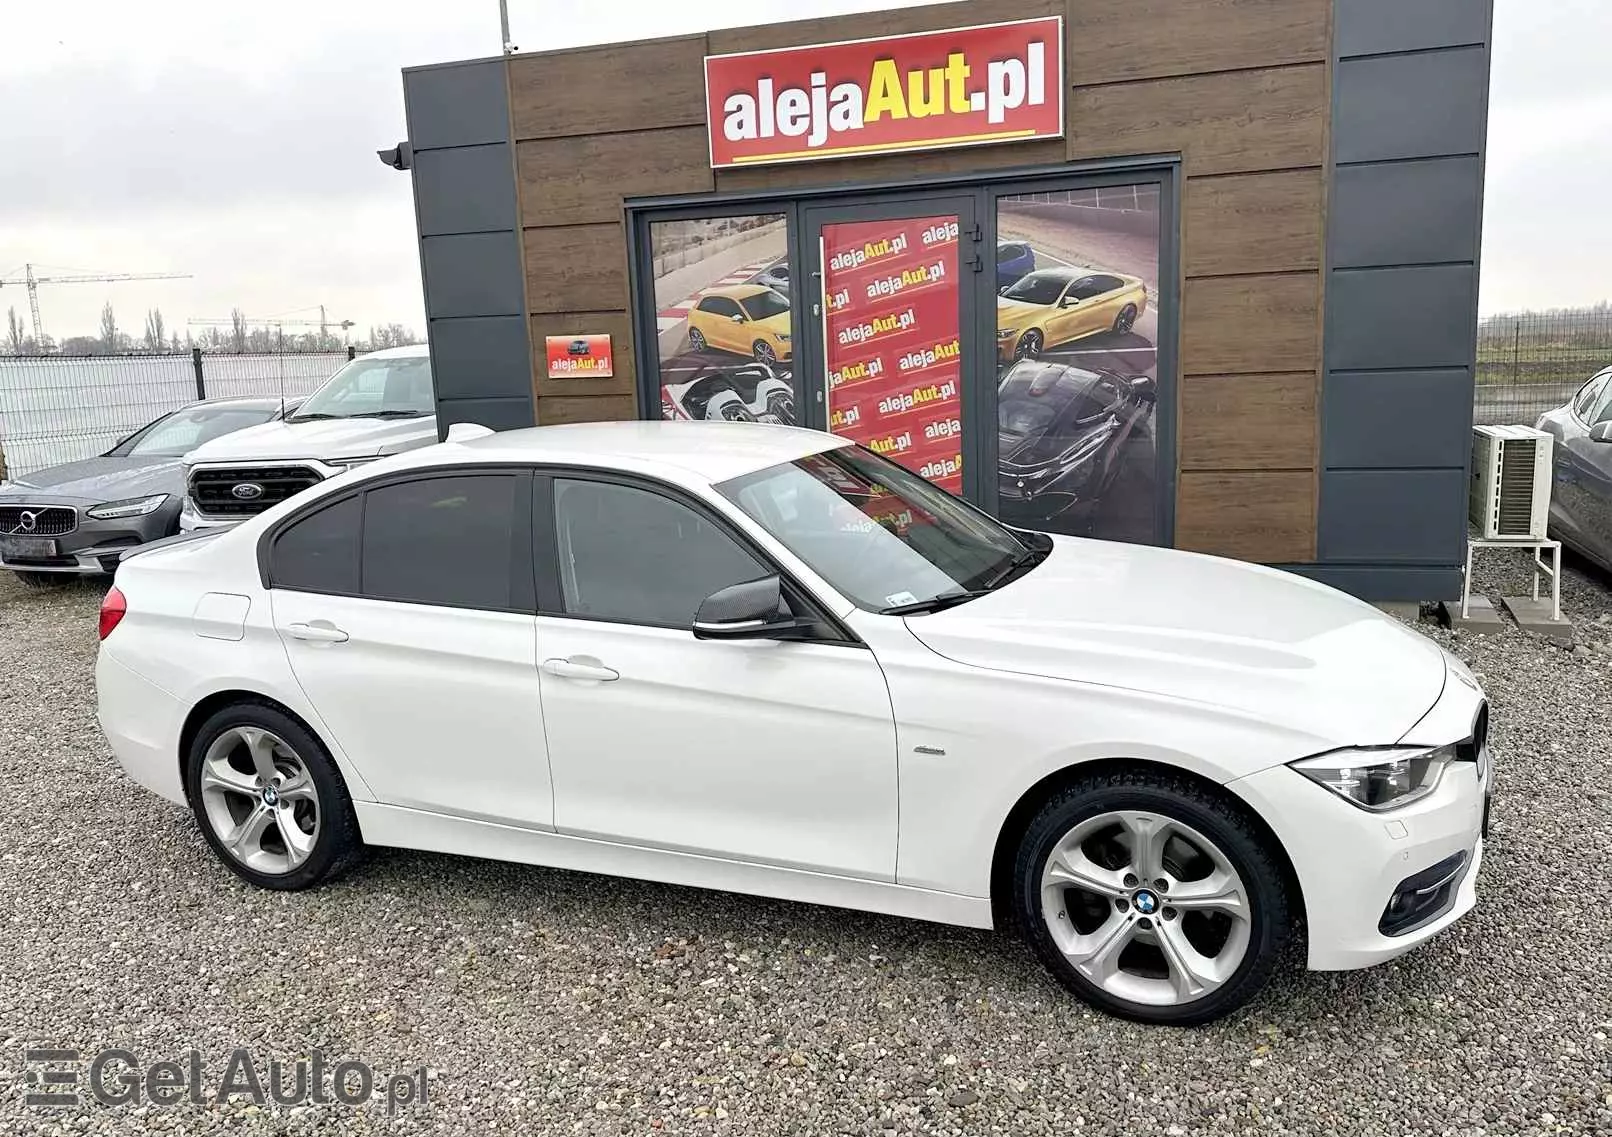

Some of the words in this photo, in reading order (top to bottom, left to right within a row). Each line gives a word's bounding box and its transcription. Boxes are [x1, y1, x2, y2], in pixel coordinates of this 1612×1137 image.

[723, 41, 1045, 147] alejaAut.pl
[830, 233, 908, 270] alejaAut.pl
[866, 261, 945, 297] alejaAut.pl
[838, 309, 915, 344] alejaAut.pl
[551, 357, 609, 373] alejaAut.pl
[878, 381, 956, 414] alejaAut.pl
